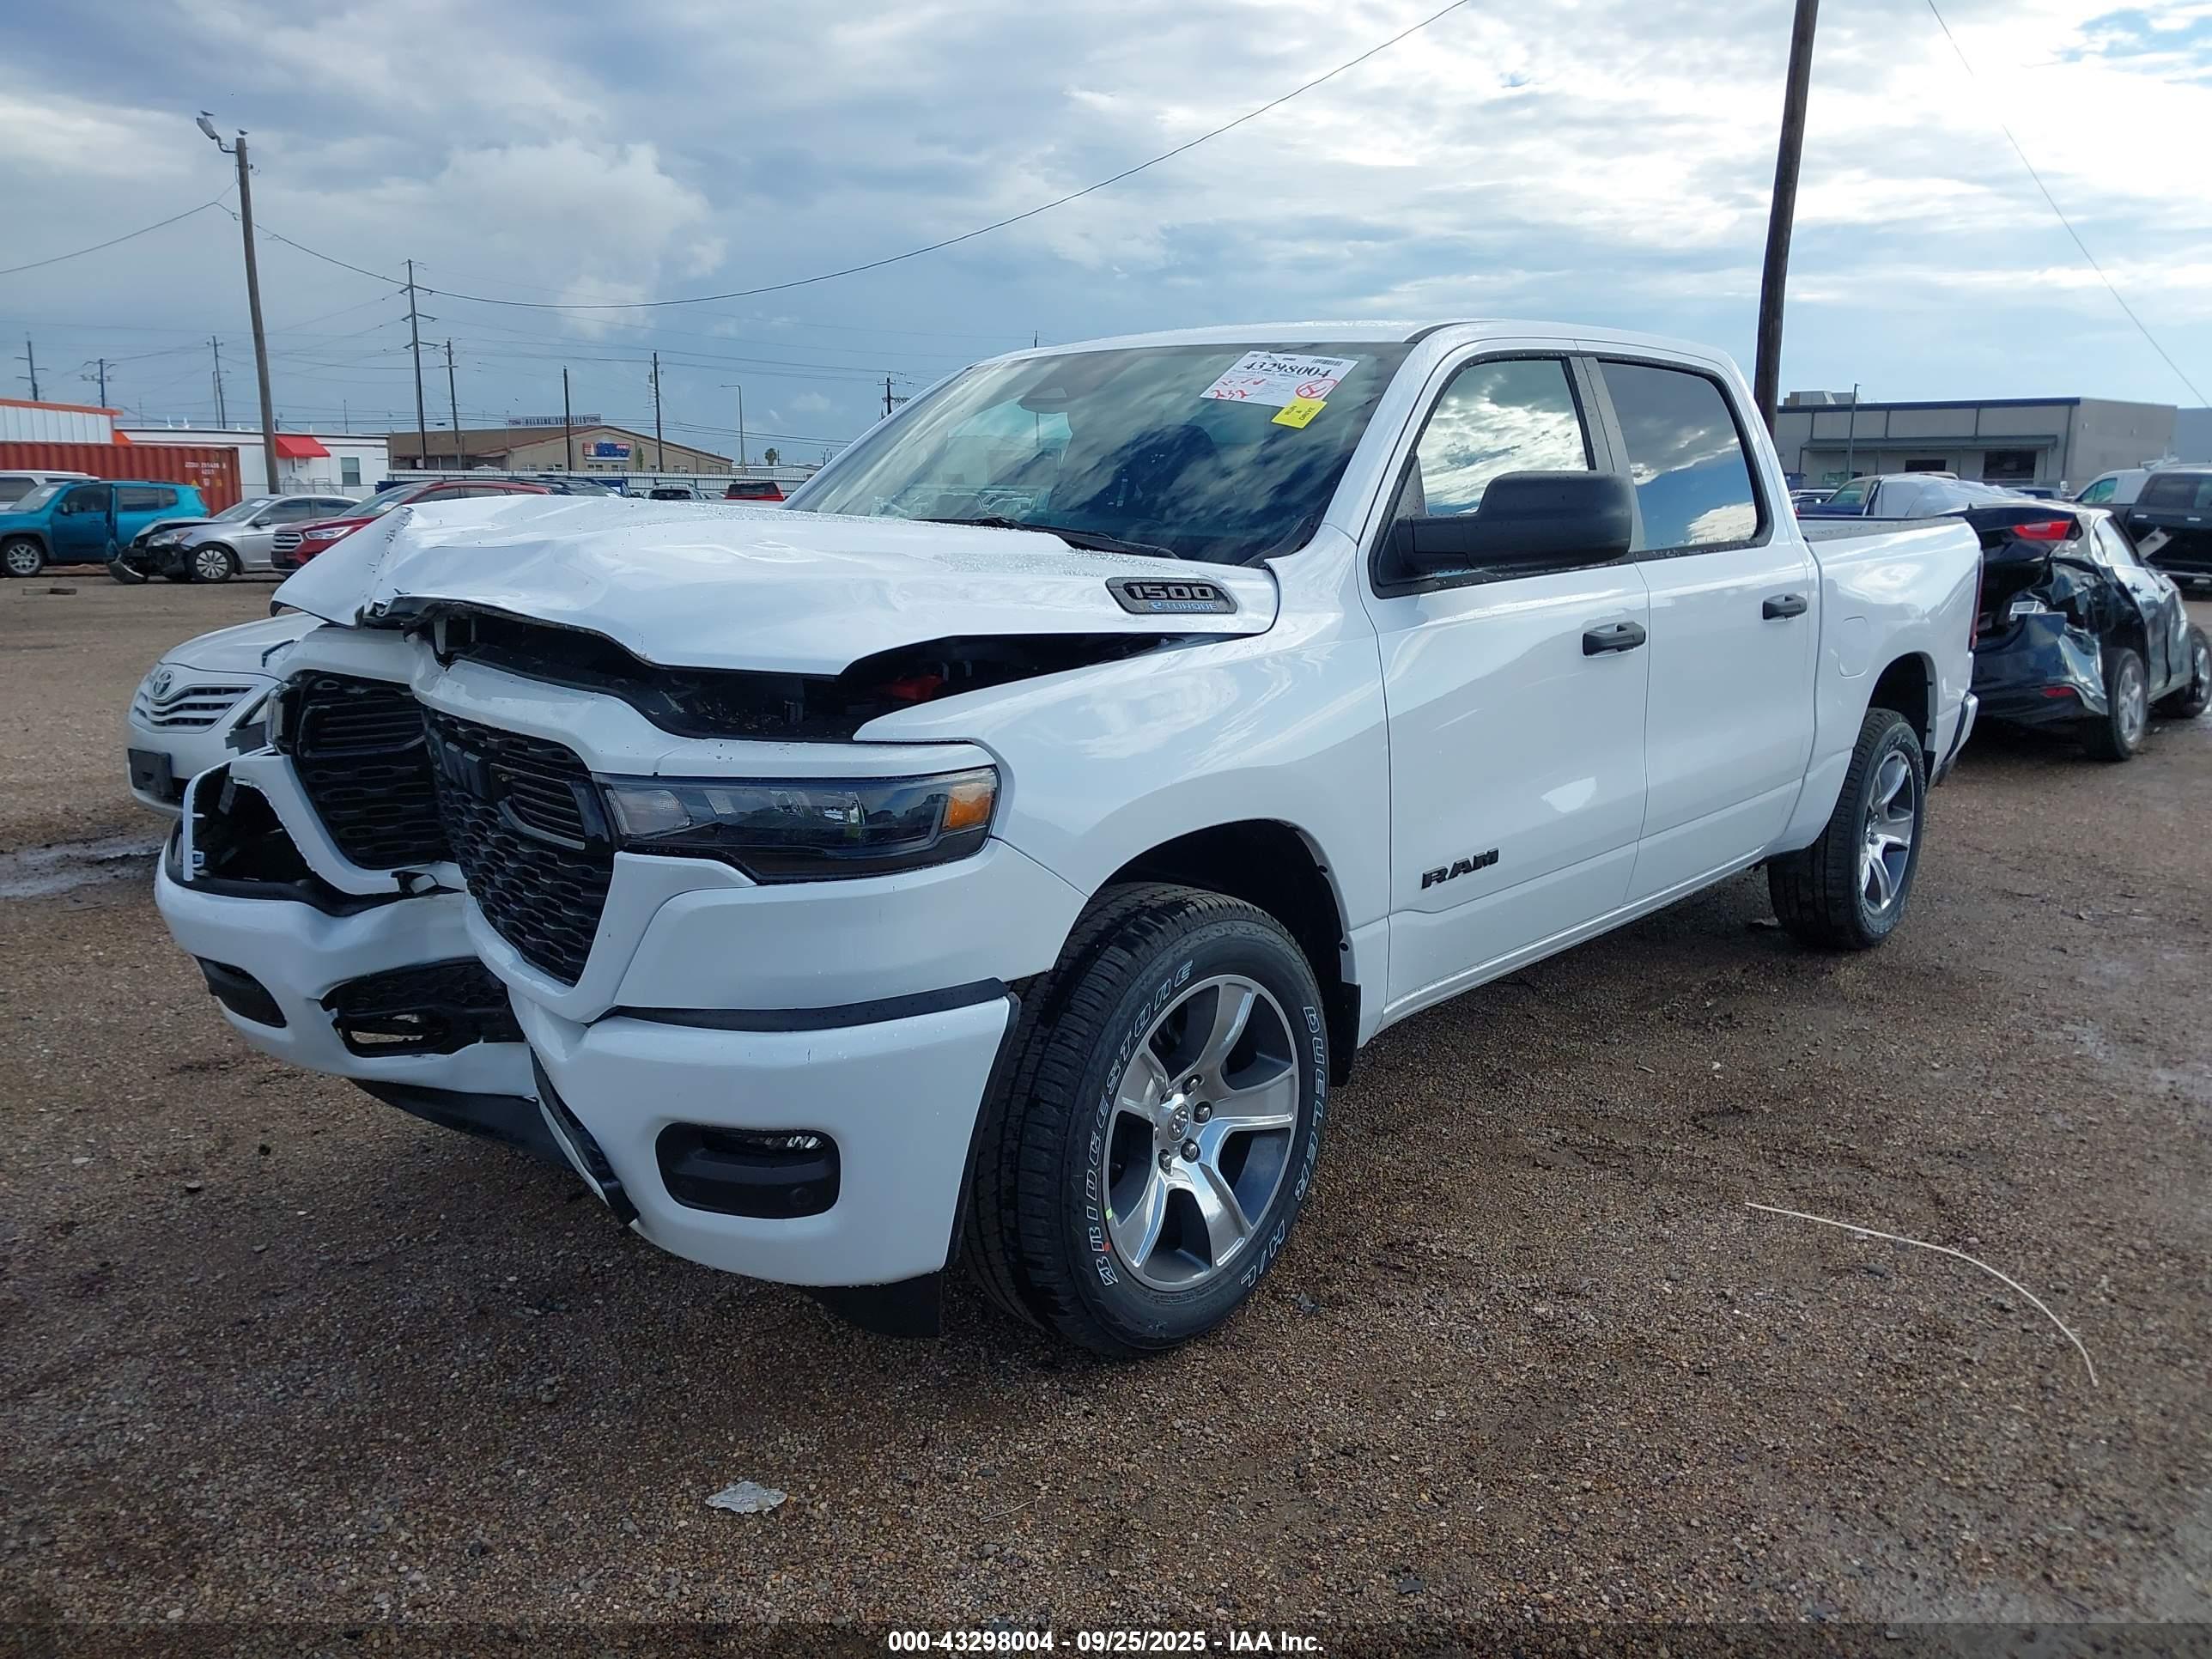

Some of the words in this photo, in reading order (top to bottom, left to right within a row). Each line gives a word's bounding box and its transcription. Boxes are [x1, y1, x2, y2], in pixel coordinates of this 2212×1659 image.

[1243, 362, 1332, 378] 43298004
[1298, 406, 1315, 421] DRIVE
[1130, 586, 1214, 599] 1500
[1421, 847, 1499, 890] RAM
[1294, 1006, 1327, 1202] DUELER
[1085, 959, 1193, 1287] BRIDGESTONE
